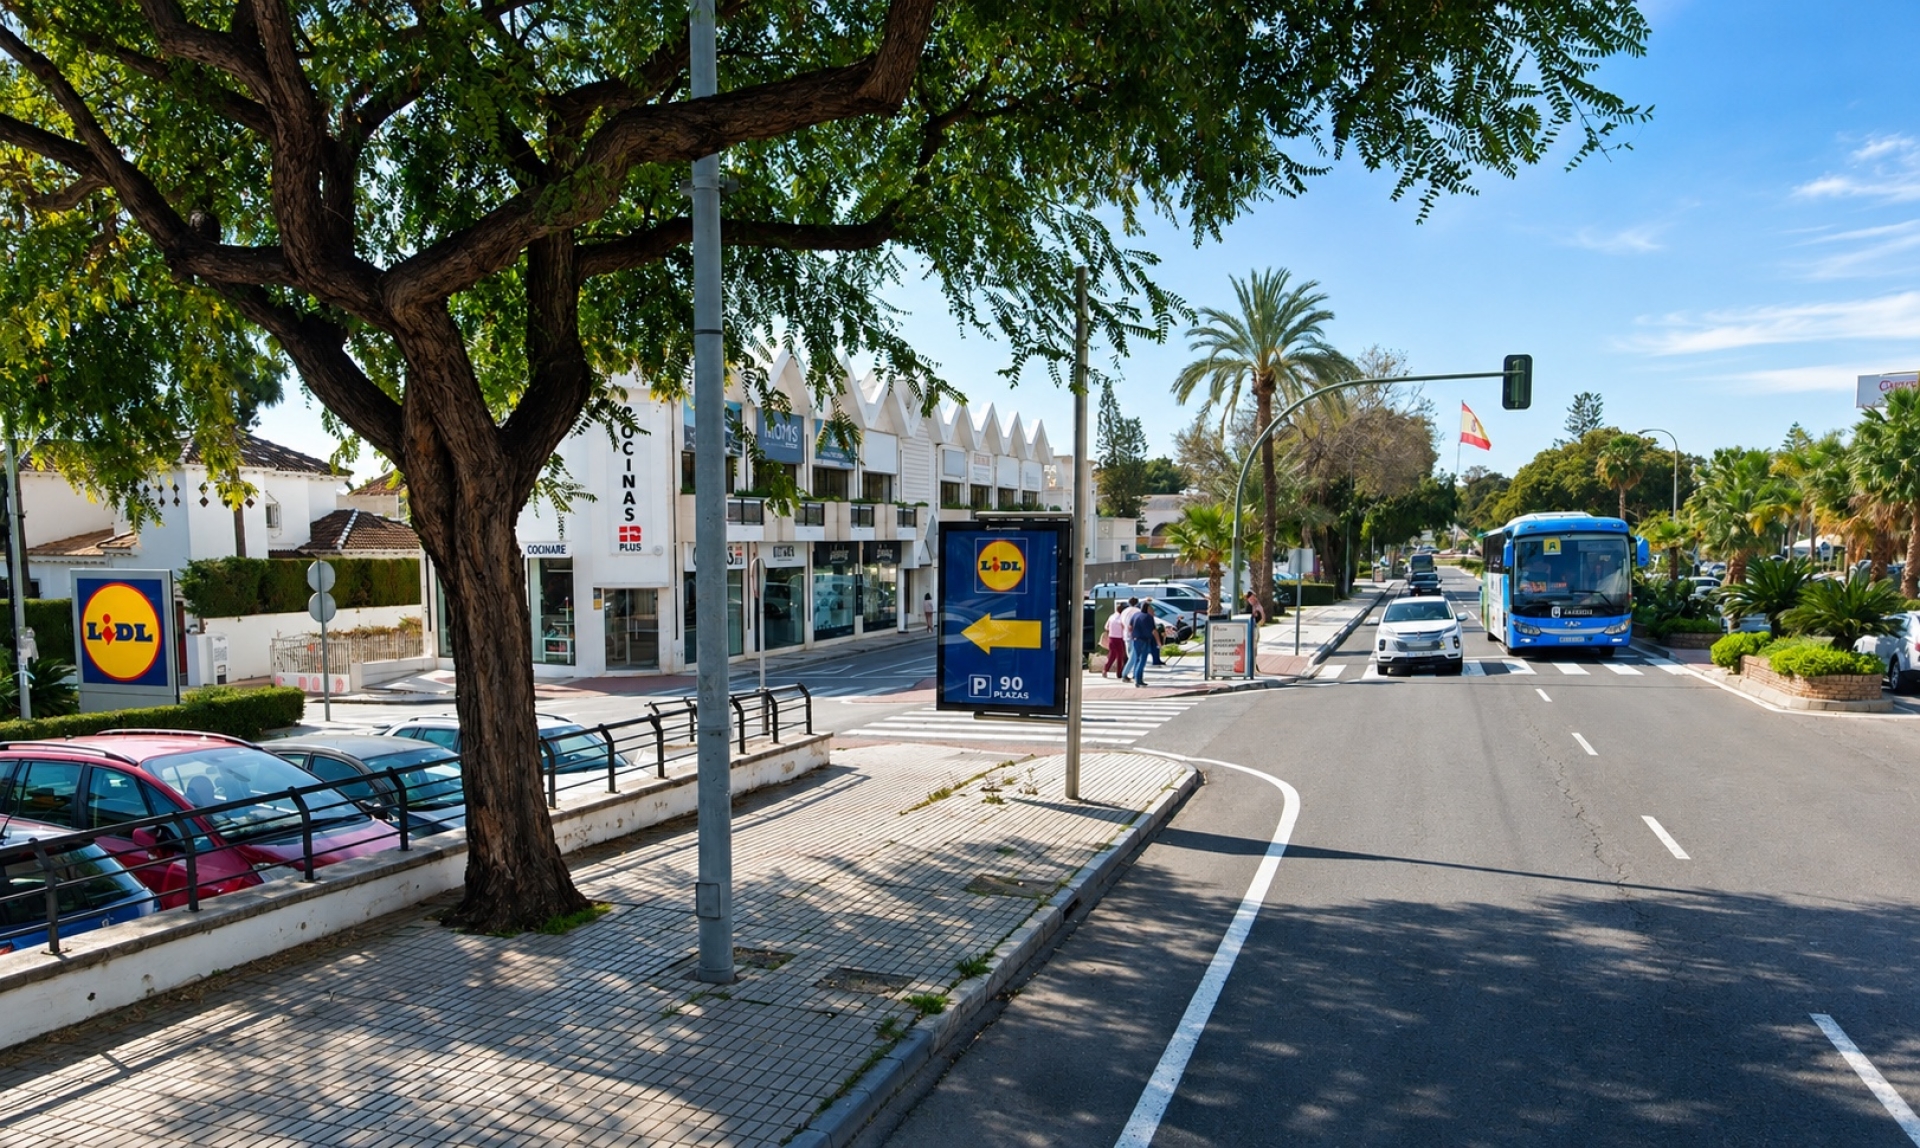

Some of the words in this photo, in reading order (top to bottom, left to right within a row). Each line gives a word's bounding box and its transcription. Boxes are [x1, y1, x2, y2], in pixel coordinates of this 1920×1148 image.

[619, 543, 642, 552] PLUS
[973, 677, 987, 695] P
[1000, 676, 1023, 691] 90
[993, 690, 1030, 700] PLAZAS
